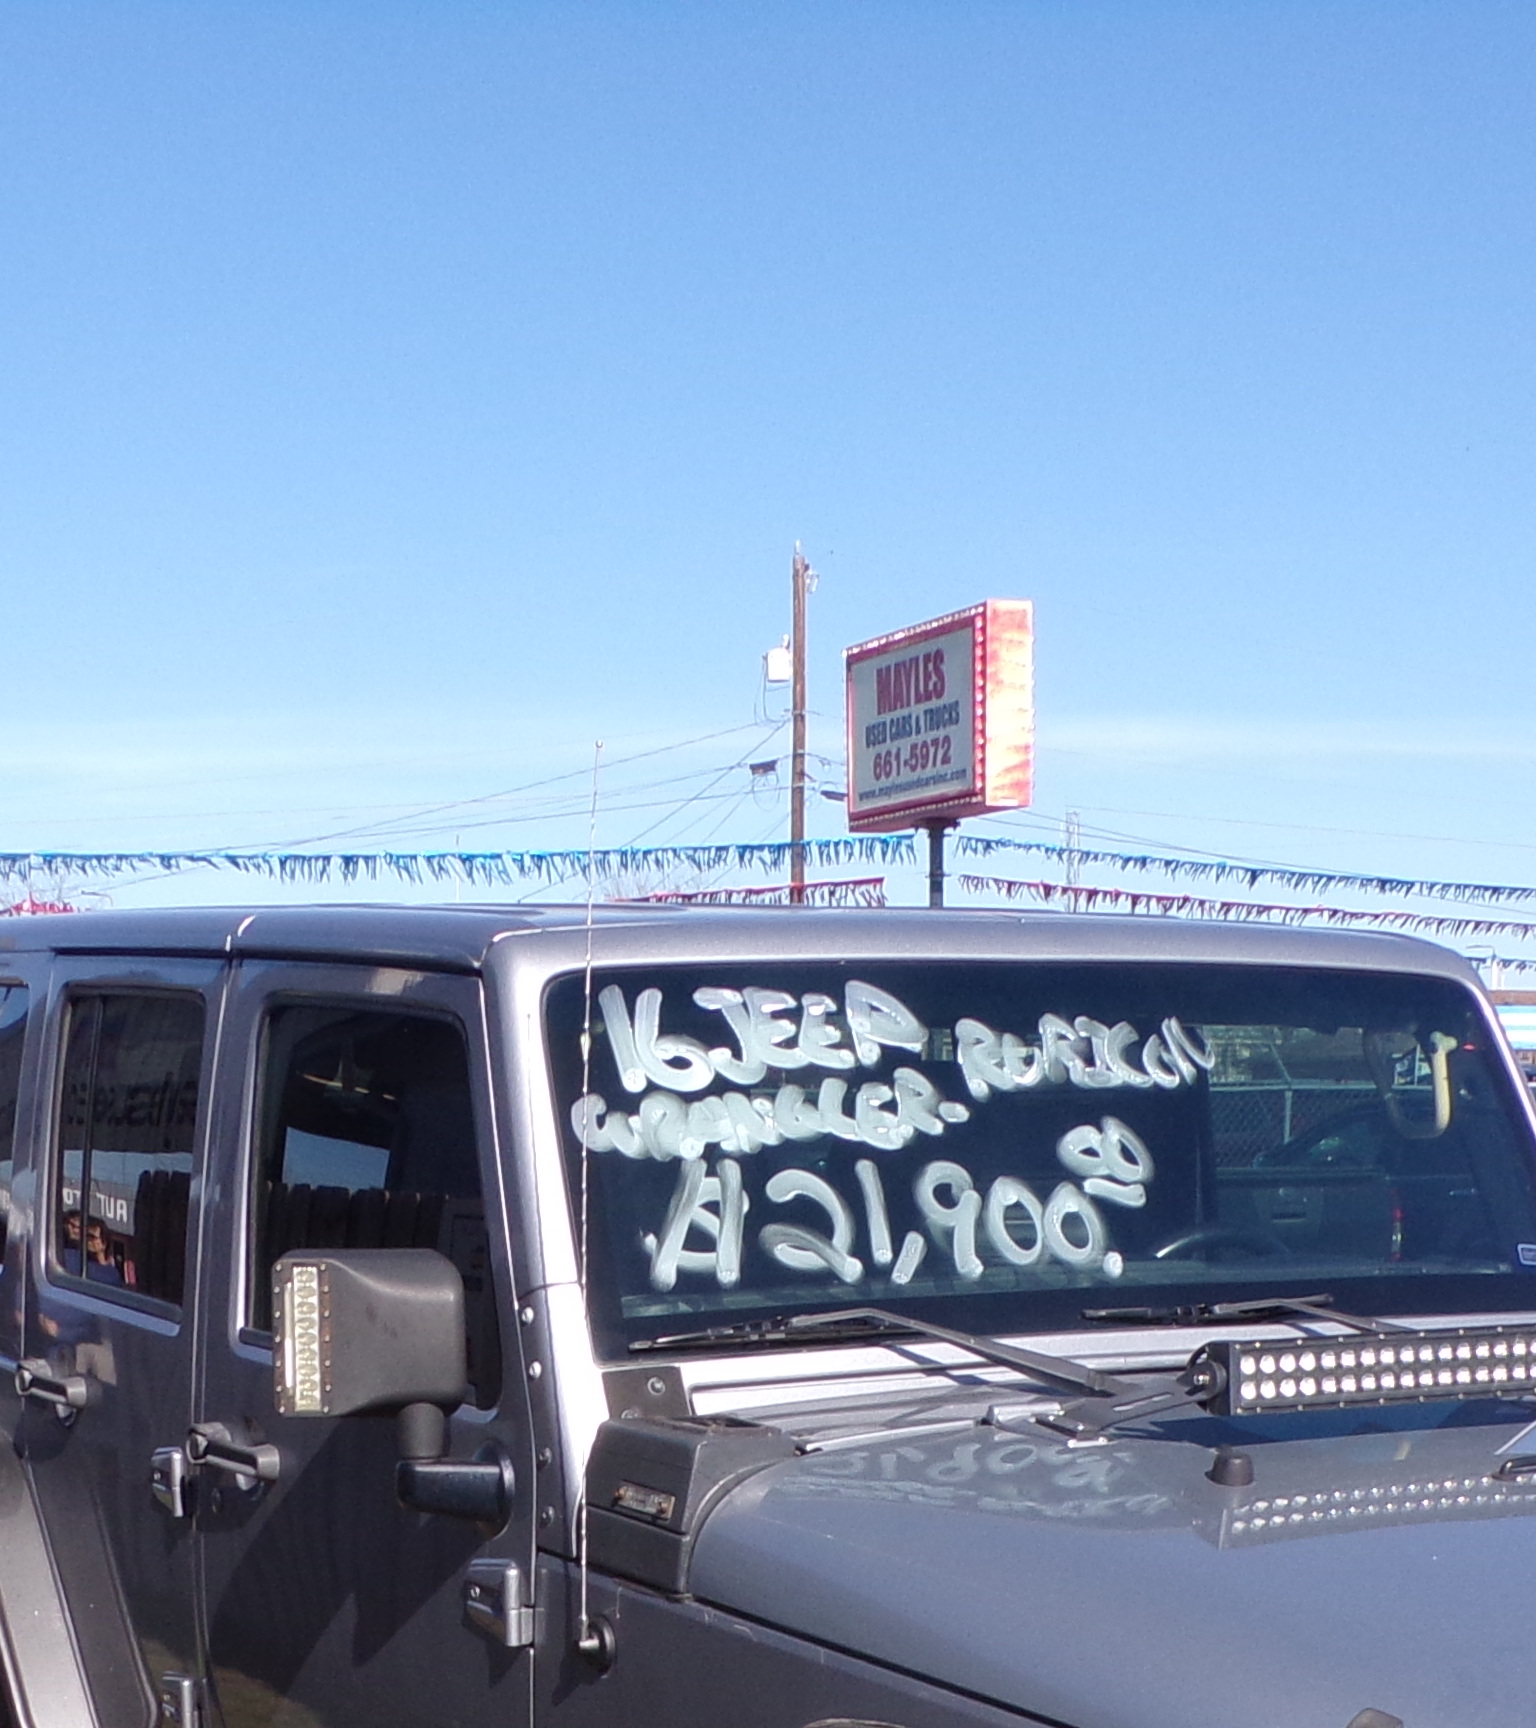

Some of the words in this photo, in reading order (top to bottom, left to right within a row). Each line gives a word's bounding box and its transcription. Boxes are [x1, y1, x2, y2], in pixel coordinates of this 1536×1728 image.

[875, 649, 945, 715] MAYLES
[865, 721, 887, 748] USED
[889, 713, 913, 742] CARS
[923, 700, 960, 733] TRUCKS
[872, 735, 952, 781] 661-5972
